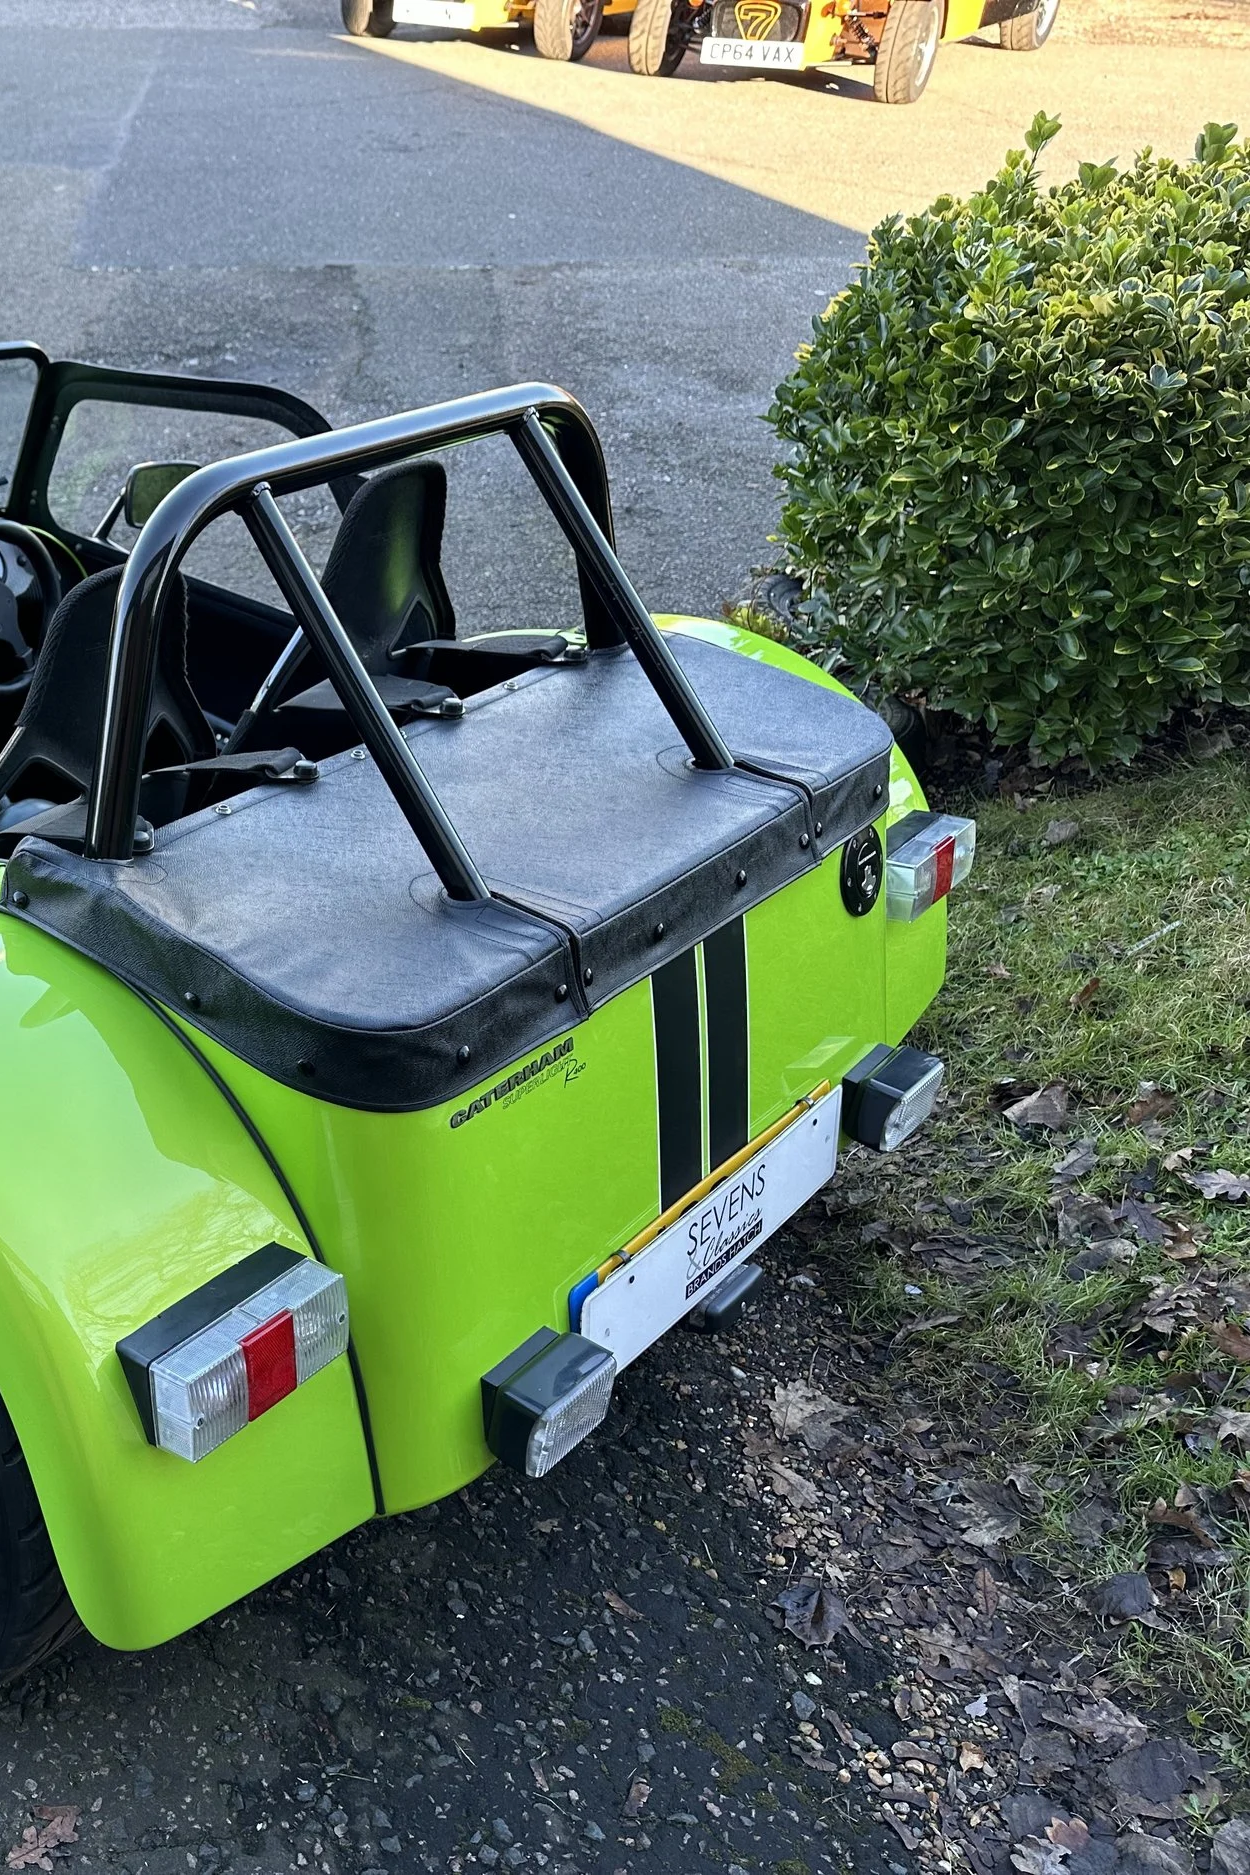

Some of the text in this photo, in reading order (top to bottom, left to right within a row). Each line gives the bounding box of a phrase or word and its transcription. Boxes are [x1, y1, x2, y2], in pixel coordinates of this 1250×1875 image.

[710, 43, 795, 62] CP64 VAX
[450, 1036, 574, 1129] CATERHAM
[502, 1053, 573, 1110] SUPERLIGHT
[686, 1164, 766, 1256] SEVENS
[686, 1207, 763, 1280] & Classics
[687, 1225, 762, 1297] BRANDS HATCH
